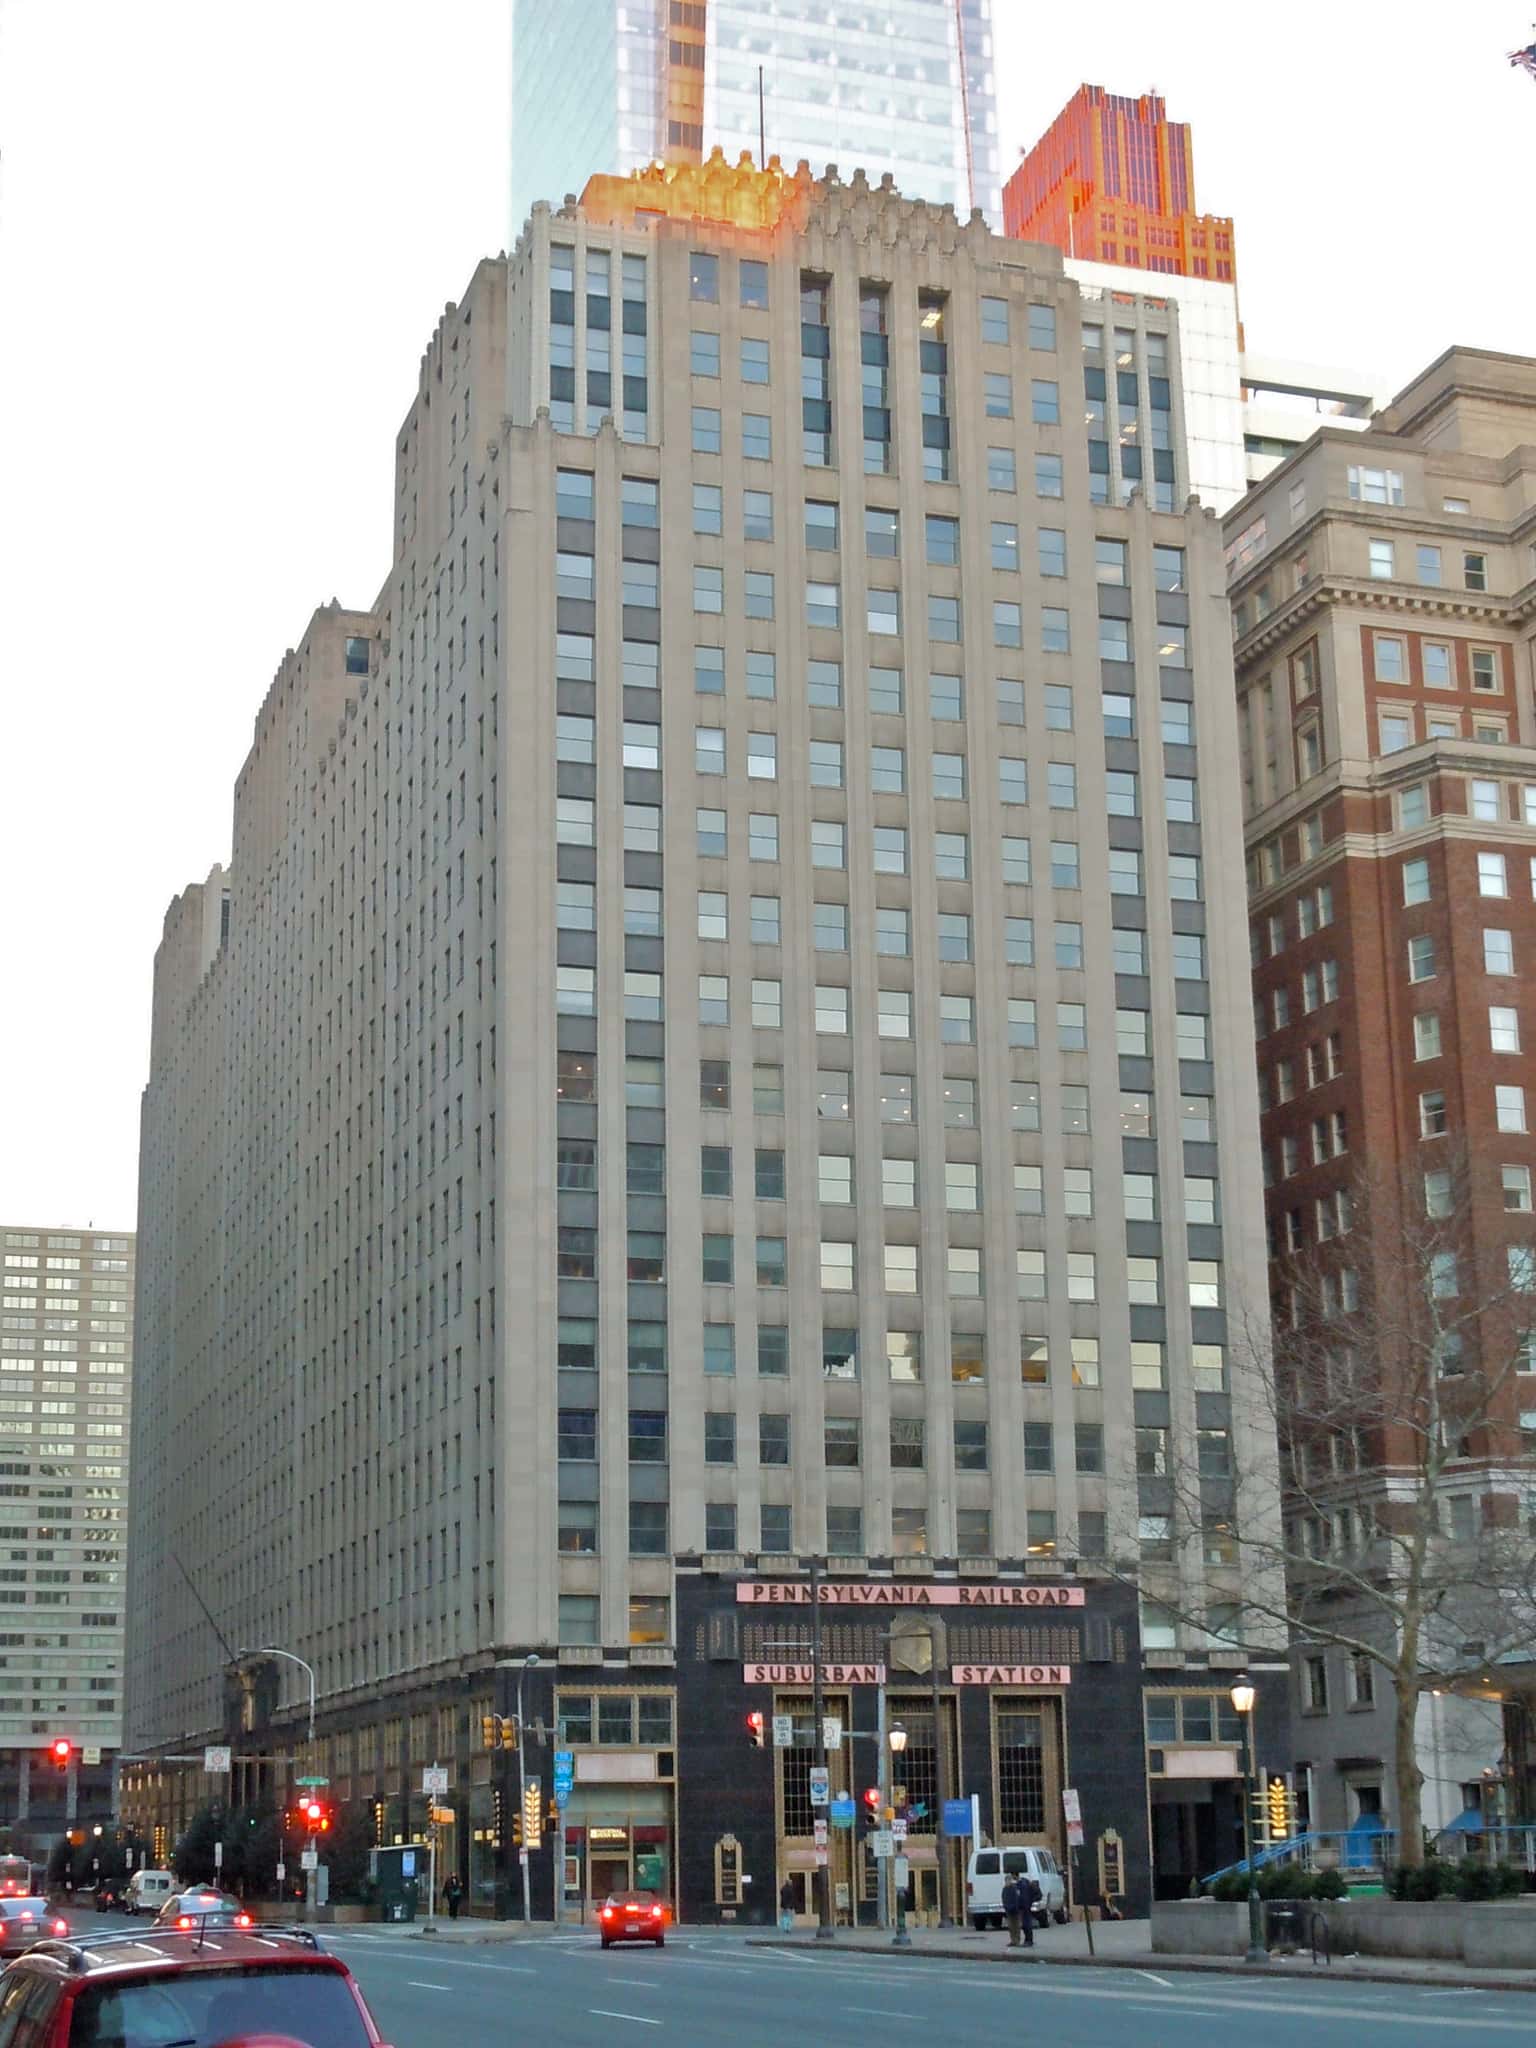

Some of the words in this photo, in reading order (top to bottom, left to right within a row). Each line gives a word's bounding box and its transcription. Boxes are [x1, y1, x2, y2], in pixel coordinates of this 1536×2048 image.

[752, 1584, 931, 1602] PENNSYLVANIA
[958, 1587, 1070, 1604] RAILROAD
[754, 1665, 877, 1682] SUBURBAN
[962, 1666, 1062, 1683] STATION
